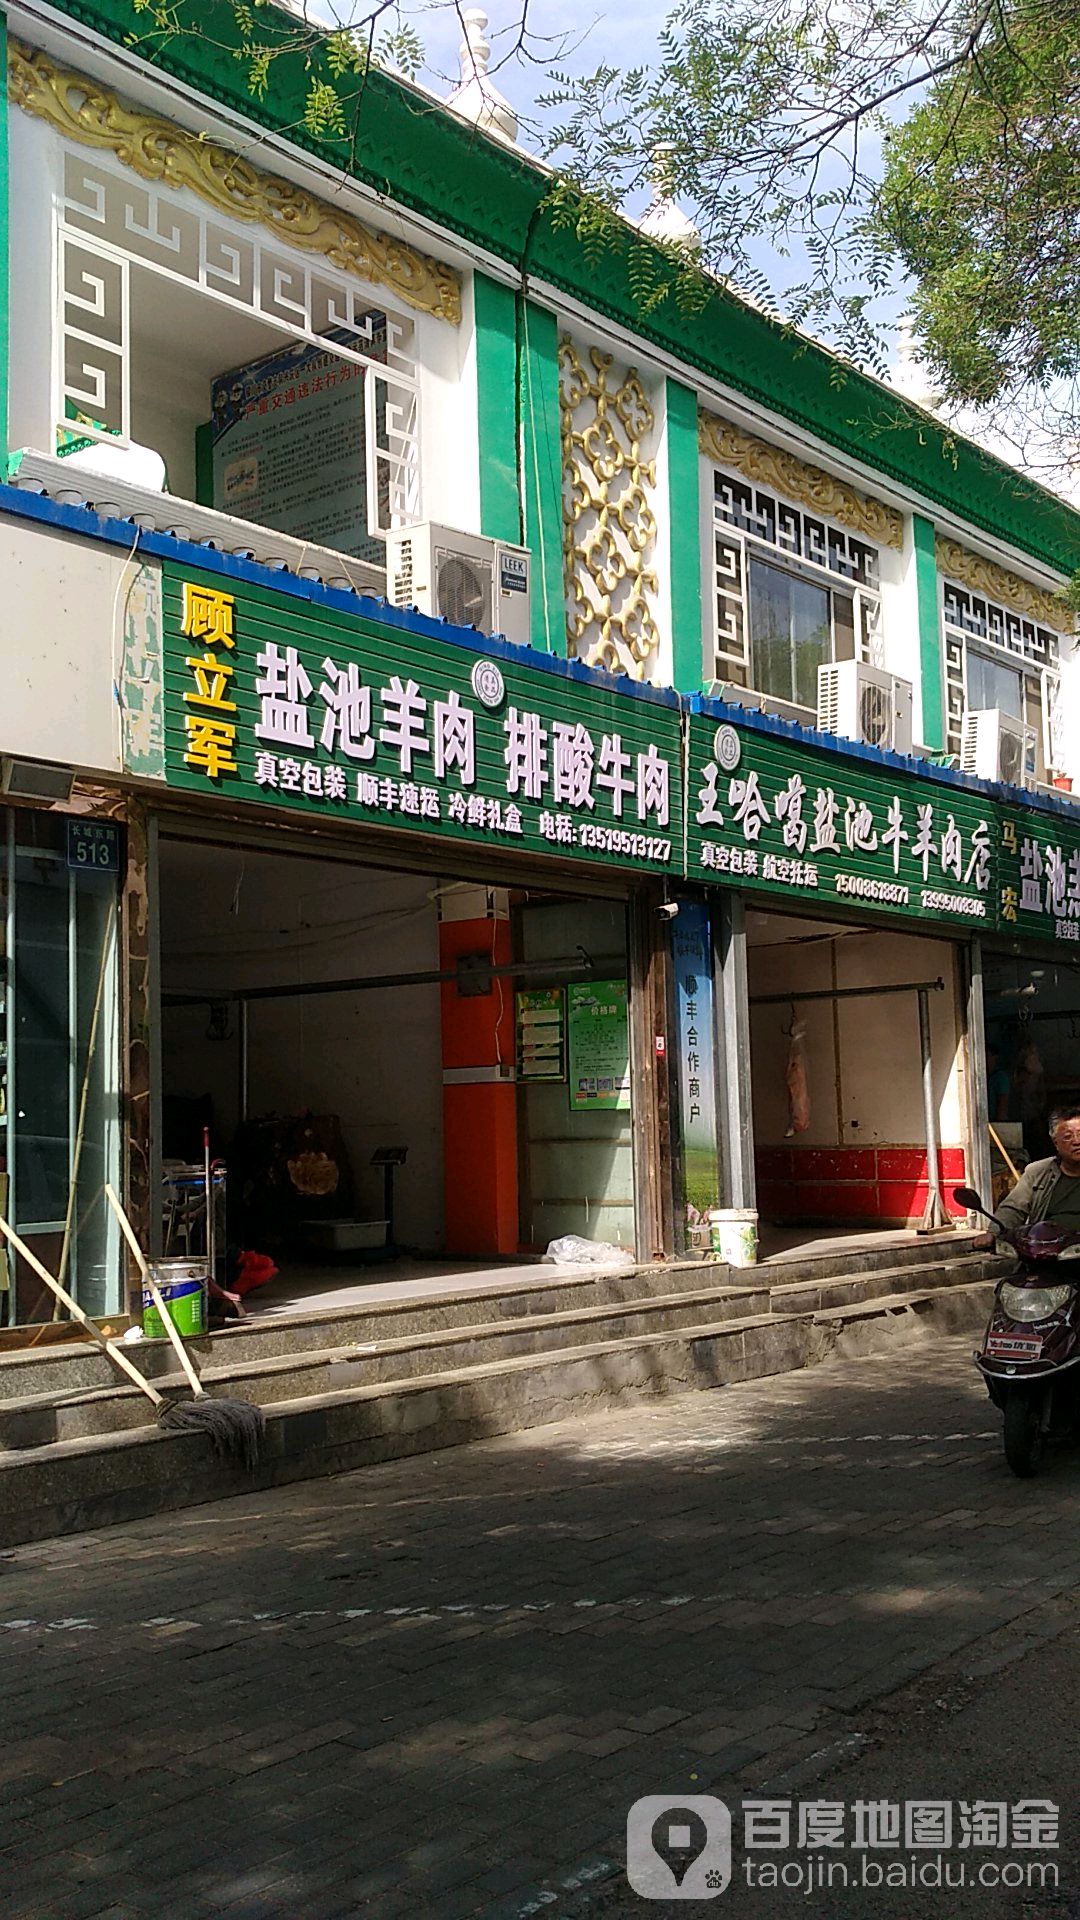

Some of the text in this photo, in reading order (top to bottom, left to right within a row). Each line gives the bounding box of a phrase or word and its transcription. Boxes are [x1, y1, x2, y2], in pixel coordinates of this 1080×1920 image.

[504, 557, 524, 573] LEEK
[180, 582, 237, 778] 顾立军
[254, 641, 669, 827] 盐池羊肉 排酸牛肉
[254, 752, 347, 800] 真空包装
[357, 772, 441, 818] 顺丰速运
[448, 791, 524, 834] 冷鲜礼盒
[76, 841, 110, 865] 513
[700, 842, 759, 876] 真空包装
[763, 854, 819, 888] 航空托运
[685, 975, 701, 1124] 顺丰合作商户
